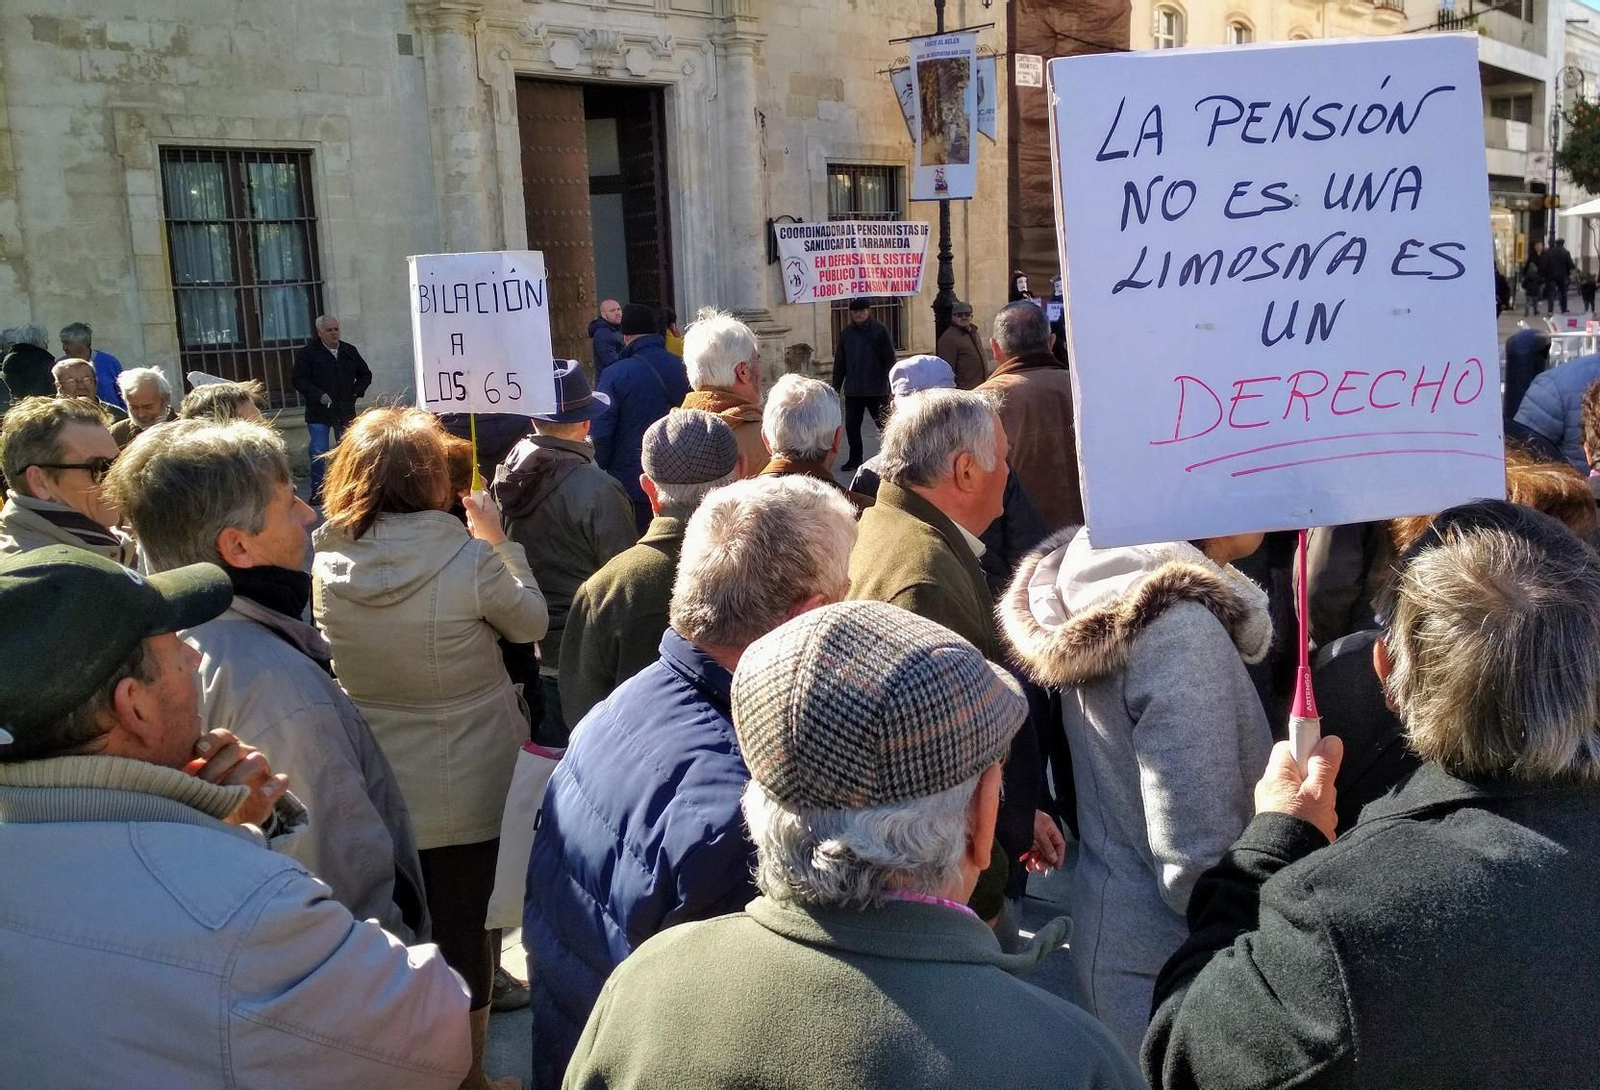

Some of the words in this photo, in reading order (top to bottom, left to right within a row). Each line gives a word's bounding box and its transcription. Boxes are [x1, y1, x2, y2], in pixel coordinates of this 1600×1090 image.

[1095, 96, 1163, 162] LA
[1195, 75, 1456, 146] PENSIÓN
[1120, 175, 1197, 231] NO
[1223, 180, 1293, 219] ES
[1323, 166, 1423, 212] UNA
[780, 225, 845, 239] COORDINADORA
[857, 224, 919, 236] PENSIONISTAS
[845, 237, 857, 249] DE
[814, 255, 826, 268] EN
[828, 253, 866, 267] DEFENSA
[819, 267, 856, 282] PÚBLICO
[1111, 231, 1367, 295] LIMOSNA
[1391, 238, 1466, 280] ES
[812, 283, 837, 298] 1.080
[1261, 299, 1345, 347] UN
[450, 333, 464, 356] A
[423, 371, 467, 403] LOS
[484, 371, 522, 404] 65
[1150, 358, 1484, 445] DERECHO
